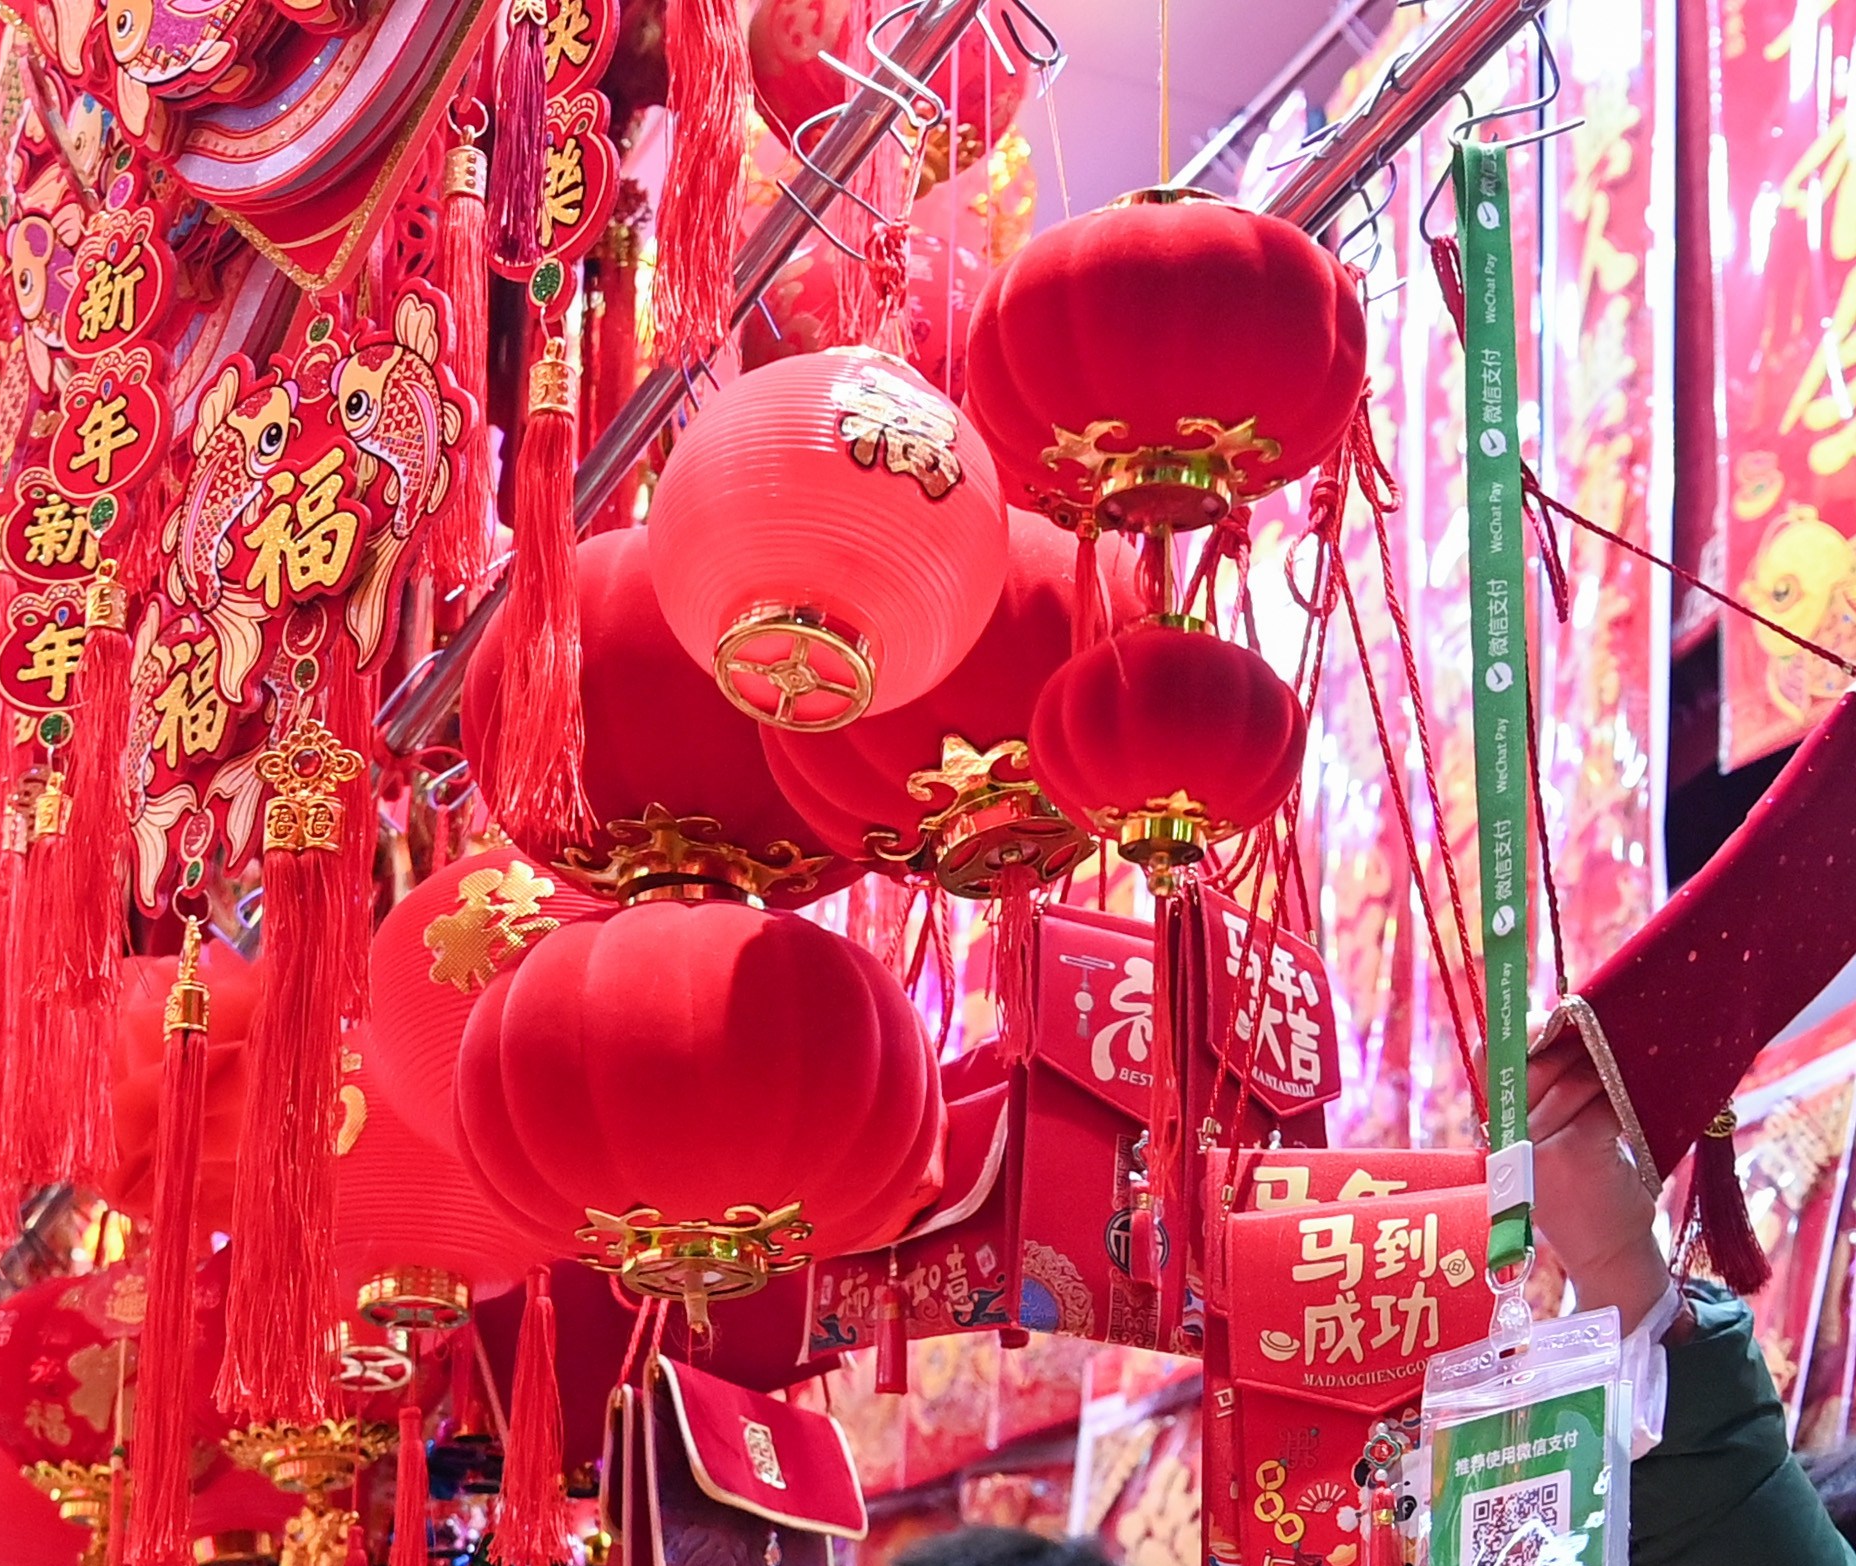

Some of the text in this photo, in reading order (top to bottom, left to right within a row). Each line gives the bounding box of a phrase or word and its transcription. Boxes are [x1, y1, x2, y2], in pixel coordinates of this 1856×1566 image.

[1484, 252, 1499, 325] WeChat Pay
[69, 245, 145, 484] 新年
[1481, 348, 1503, 424] 微信支付
[243, 446, 360, 608] 福
[1489, 481, 1504, 554] WeChat Pay
[1487, 578, 1508, 657] 微信支付
[153, 637, 229, 769] 福
[1495, 717, 1510, 795] WeChat Pay
[1493, 819, 1512, 900] 微信支付
[1499, 961, 1513, 1041] WeChat Pay
[1292, 1212, 1439, 1291] 马到
[1304, 1280, 1440, 1367] 成功
[1302, 1357, 1431, 1388] MADAOCHENGGO
[1454, 1430, 1580, 1478] 推荐使用微信支付
